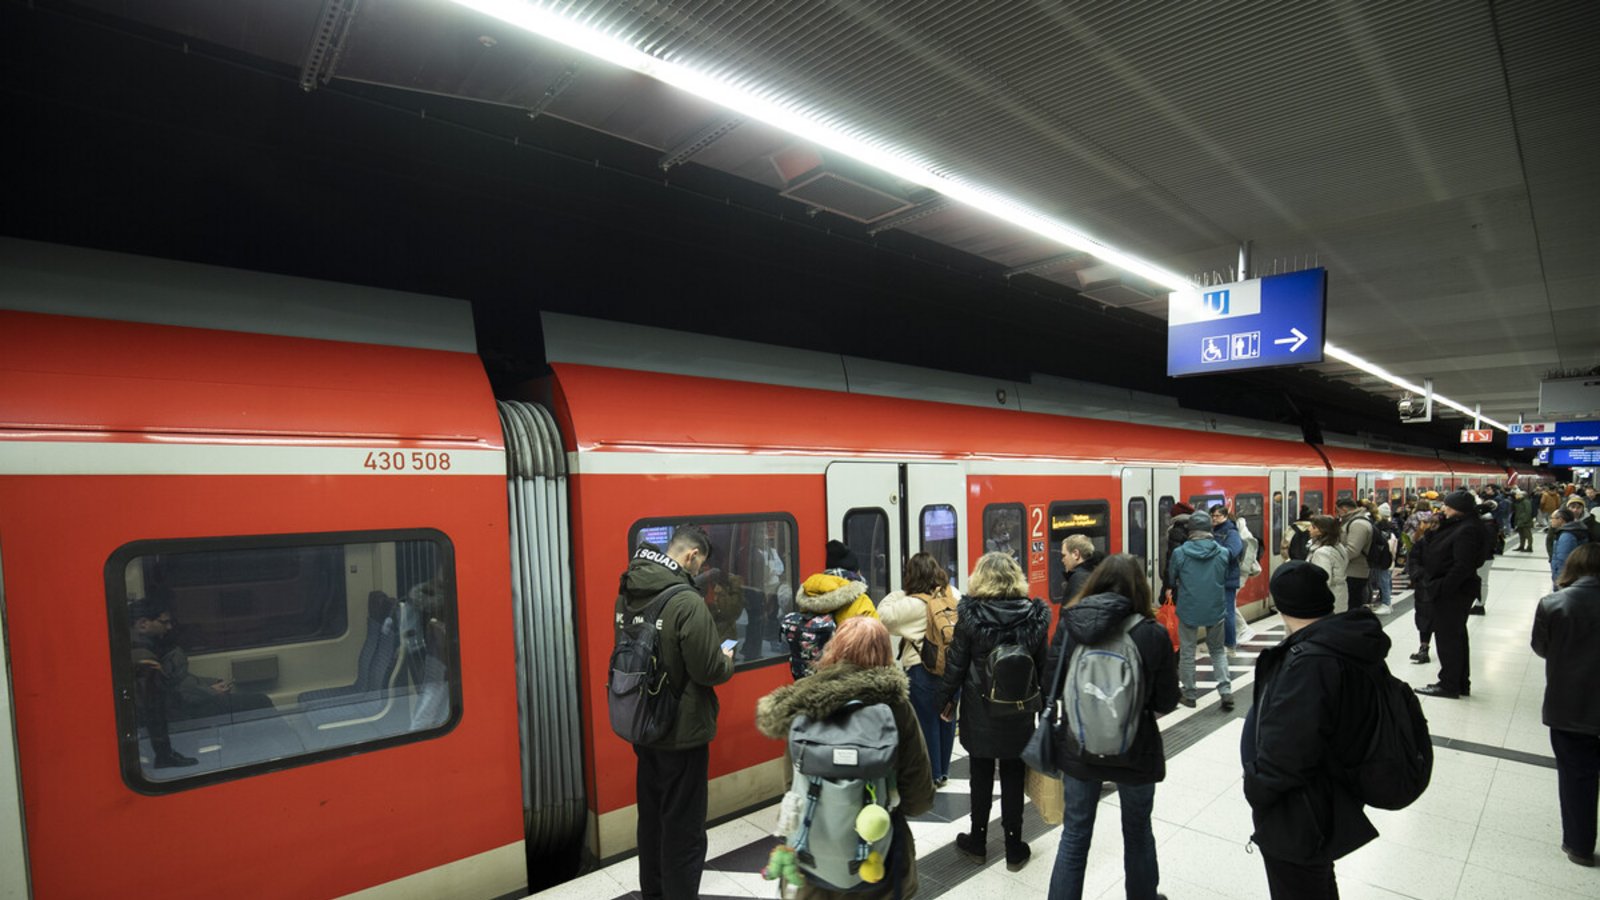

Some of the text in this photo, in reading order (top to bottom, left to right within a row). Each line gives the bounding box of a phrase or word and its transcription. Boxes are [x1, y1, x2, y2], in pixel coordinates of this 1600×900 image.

[1207, 291, 1225, 314] U
[363, 451, 451, 471] 430 508
[1031, 507, 1043, 537] 2
[639, 548, 678, 571] SQUAD
